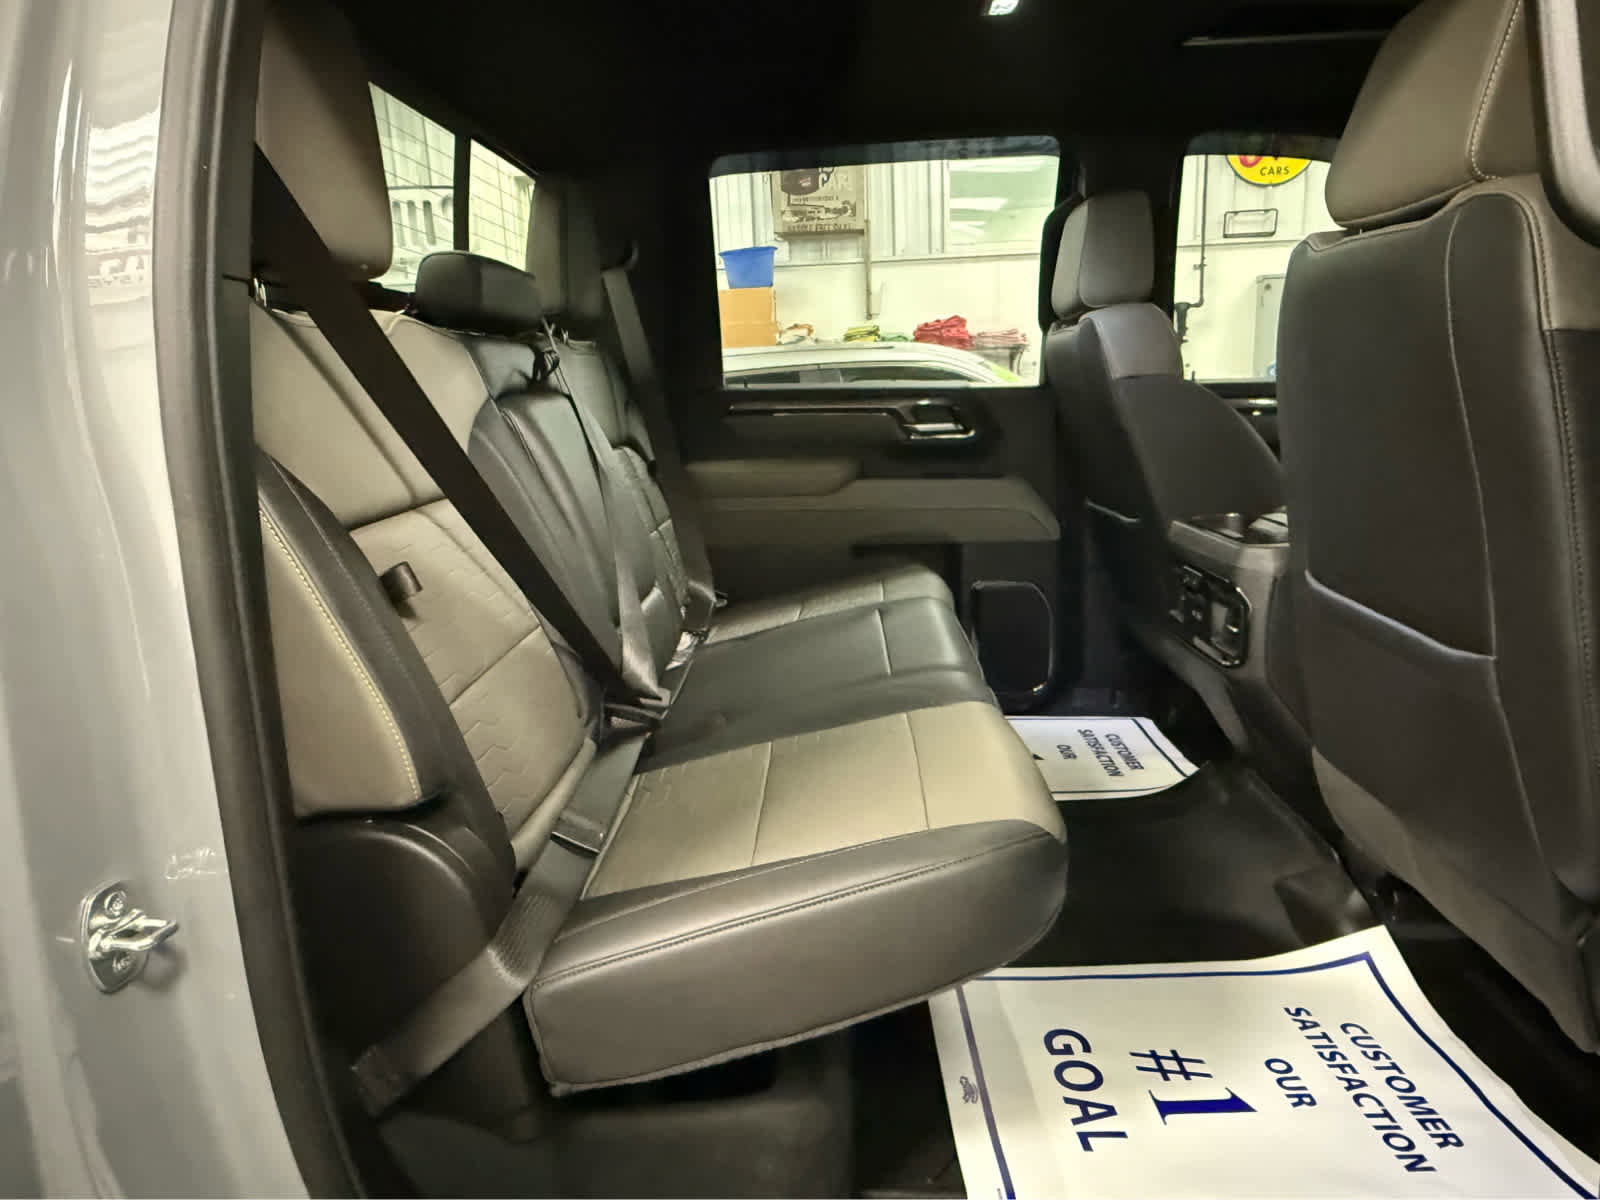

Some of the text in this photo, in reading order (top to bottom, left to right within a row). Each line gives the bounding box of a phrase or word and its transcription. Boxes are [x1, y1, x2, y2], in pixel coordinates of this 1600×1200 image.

[1259, 166, 1290, 177] CARS
[1056, 744, 1078, 760] OUR
[1077, 728, 1125, 777] SATISFACTION
[1105, 733, 1145, 771] CUSTOMER
[1043, 1028, 1129, 1153] GOAL
[1129, 1048, 1258, 1126] #1
[1264, 1057, 1318, 1109] OUR
[1283, 1006, 1436, 1173] SATISFACTION
[1339, 1021, 1465, 1150] CUSTOMER
